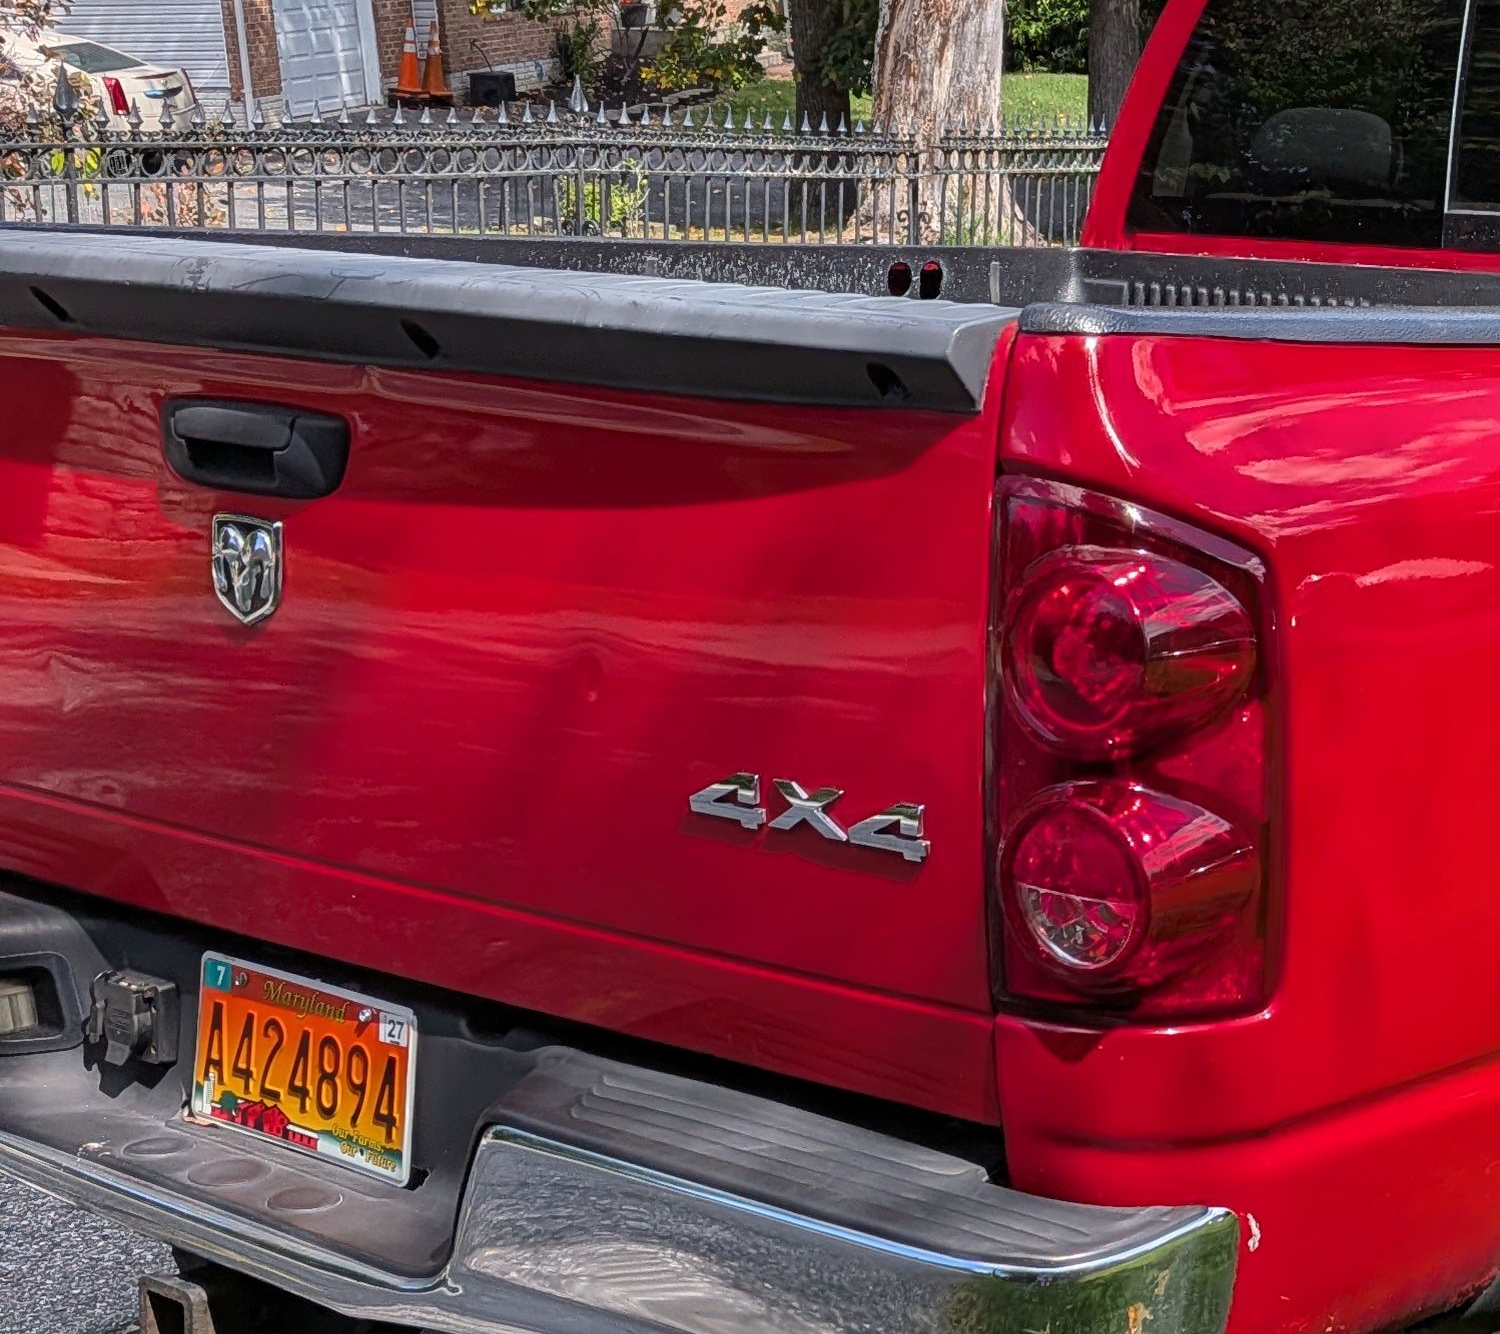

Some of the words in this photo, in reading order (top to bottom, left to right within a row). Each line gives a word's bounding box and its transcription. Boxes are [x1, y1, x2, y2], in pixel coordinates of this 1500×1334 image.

[216, 965, 226, 987] 7
[262, 979, 350, 1025] Maryland
[387, 1018, 405, 1040] 27
[203, 1000, 398, 1144] A424894
[331, 1122, 349, 1140] Our
[339, 1140, 358, 1159] Our
[364, 1150, 398, 1173] Future
